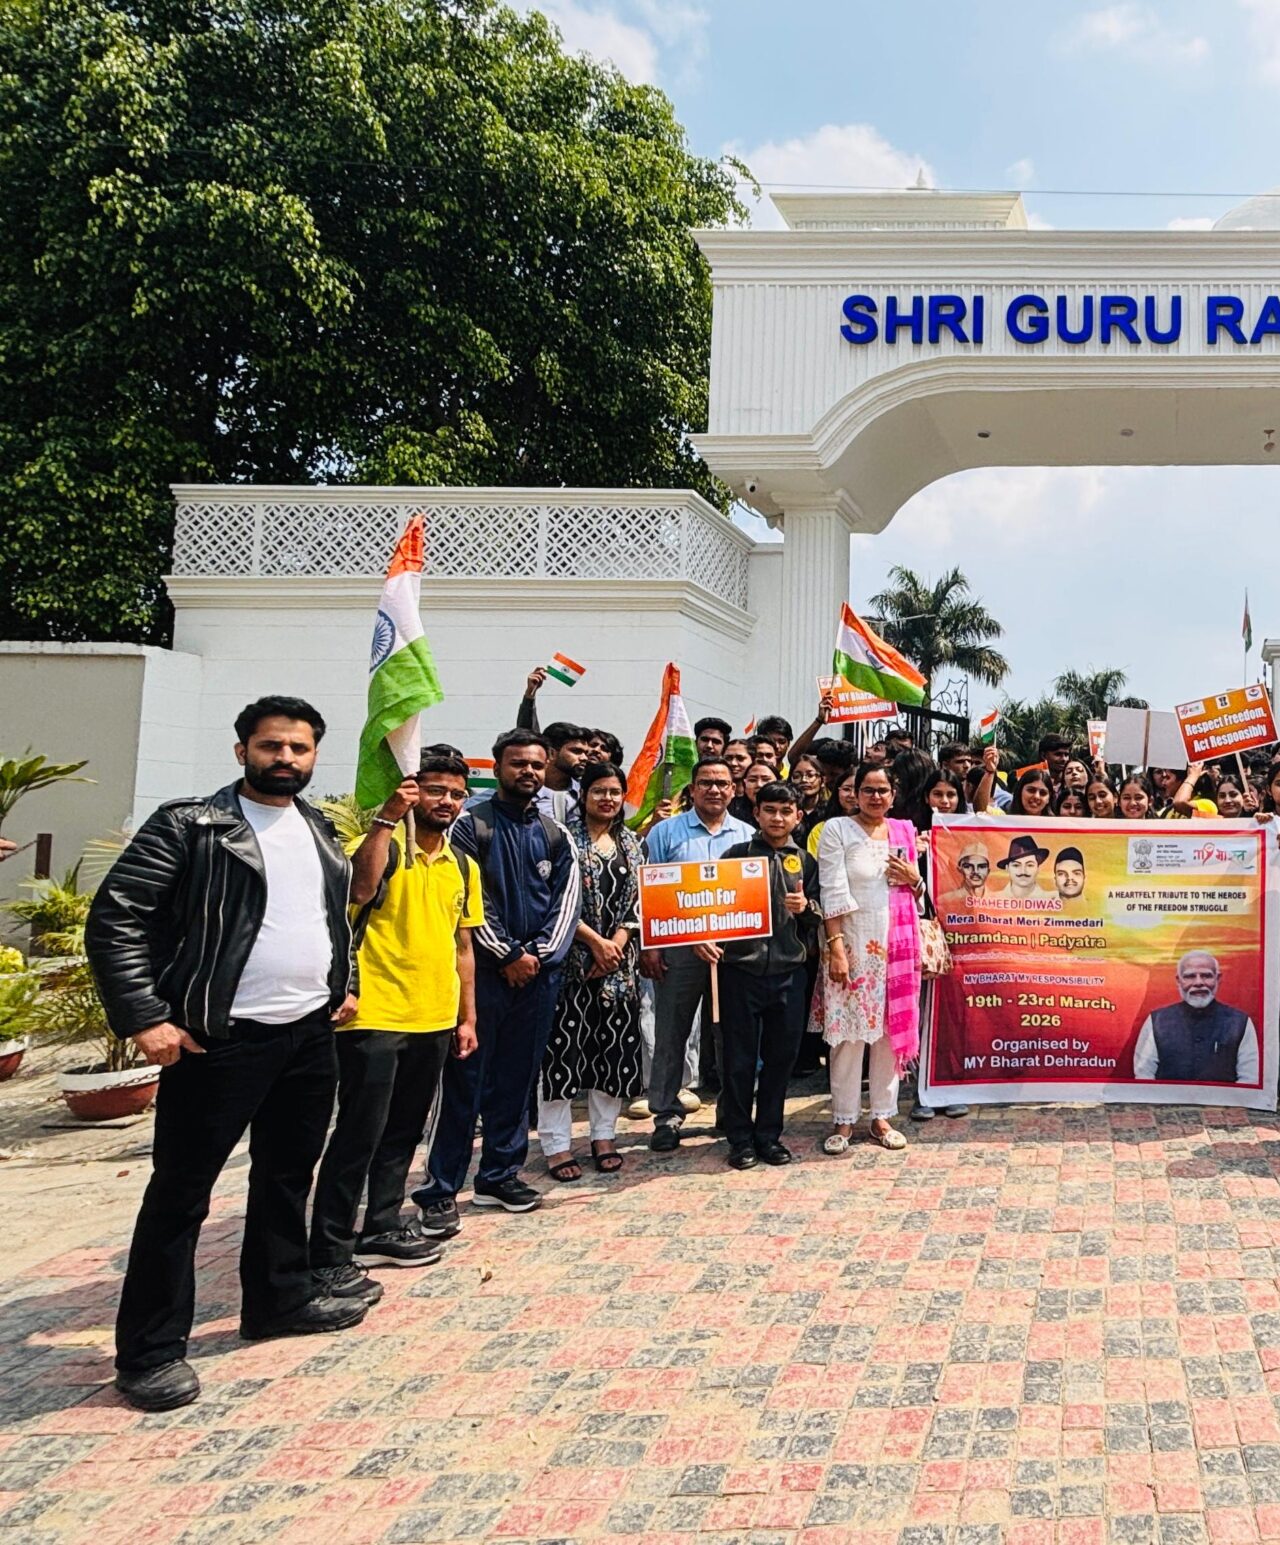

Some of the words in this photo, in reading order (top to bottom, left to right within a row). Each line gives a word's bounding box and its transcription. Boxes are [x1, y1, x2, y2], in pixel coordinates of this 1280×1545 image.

[840, 295, 983, 345] SHRI
[1006, 295, 1182, 345] GURU
[1184, 717, 1222, 736] Respect
[1193, 739, 1209, 753] Act
[1210, 724, 1267, 748] Responsibly
[676, 889, 714, 909] Youth
[716, 887, 736, 906] For
[966, 897, 1022, 910] SHAHEEDI
[1024, 899, 1062, 910] DIWAS
[1108, 891, 1114, 899] A
[1115, 891, 1155, 899] HEARTFELT
[1157, 891, 1189, 899] TRIBUTE
[1190, 891, 1200, 899] TO
[1217, 891, 1247, 900] HEROES
[1154, 904, 1188, 912] FREEDOM
[1190, 904, 1228, 912] STRUGGLE
[650, 914, 708, 938] National
[709, 910, 763, 932] Building
[947, 914, 974, 924] Mera
[978, 913, 1013, 925] Bharat
[1016, 916, 1040, 926] Meri
[1044, 917, 1104, 928] Zimmedari
[945, 931, 1027, 946] Shramdaan
[1040, 934, 1107, 950] Padyatra
[964, 975, 979, 984] MY
[980, 974, 1016, 983] BHARAT
[1032, 976, 1105, 986] RESPONSIBILITY
[966, 995, 1003, 1008] 19th
[1018, 993, 1055, 1007] 23rd
[1060, 996, 1117, 1012] March,
[1020, 1014, 1062, 1027] 2026
[991, 1038, 1069, 1053] Organised
[1072, 1038, 1090, 1053] by
[964, 1056, 987, 1070] MY
[990, 1055, 1041, 1068] Bharat
[1044, 1054, 1117, 1068] Dehradun
